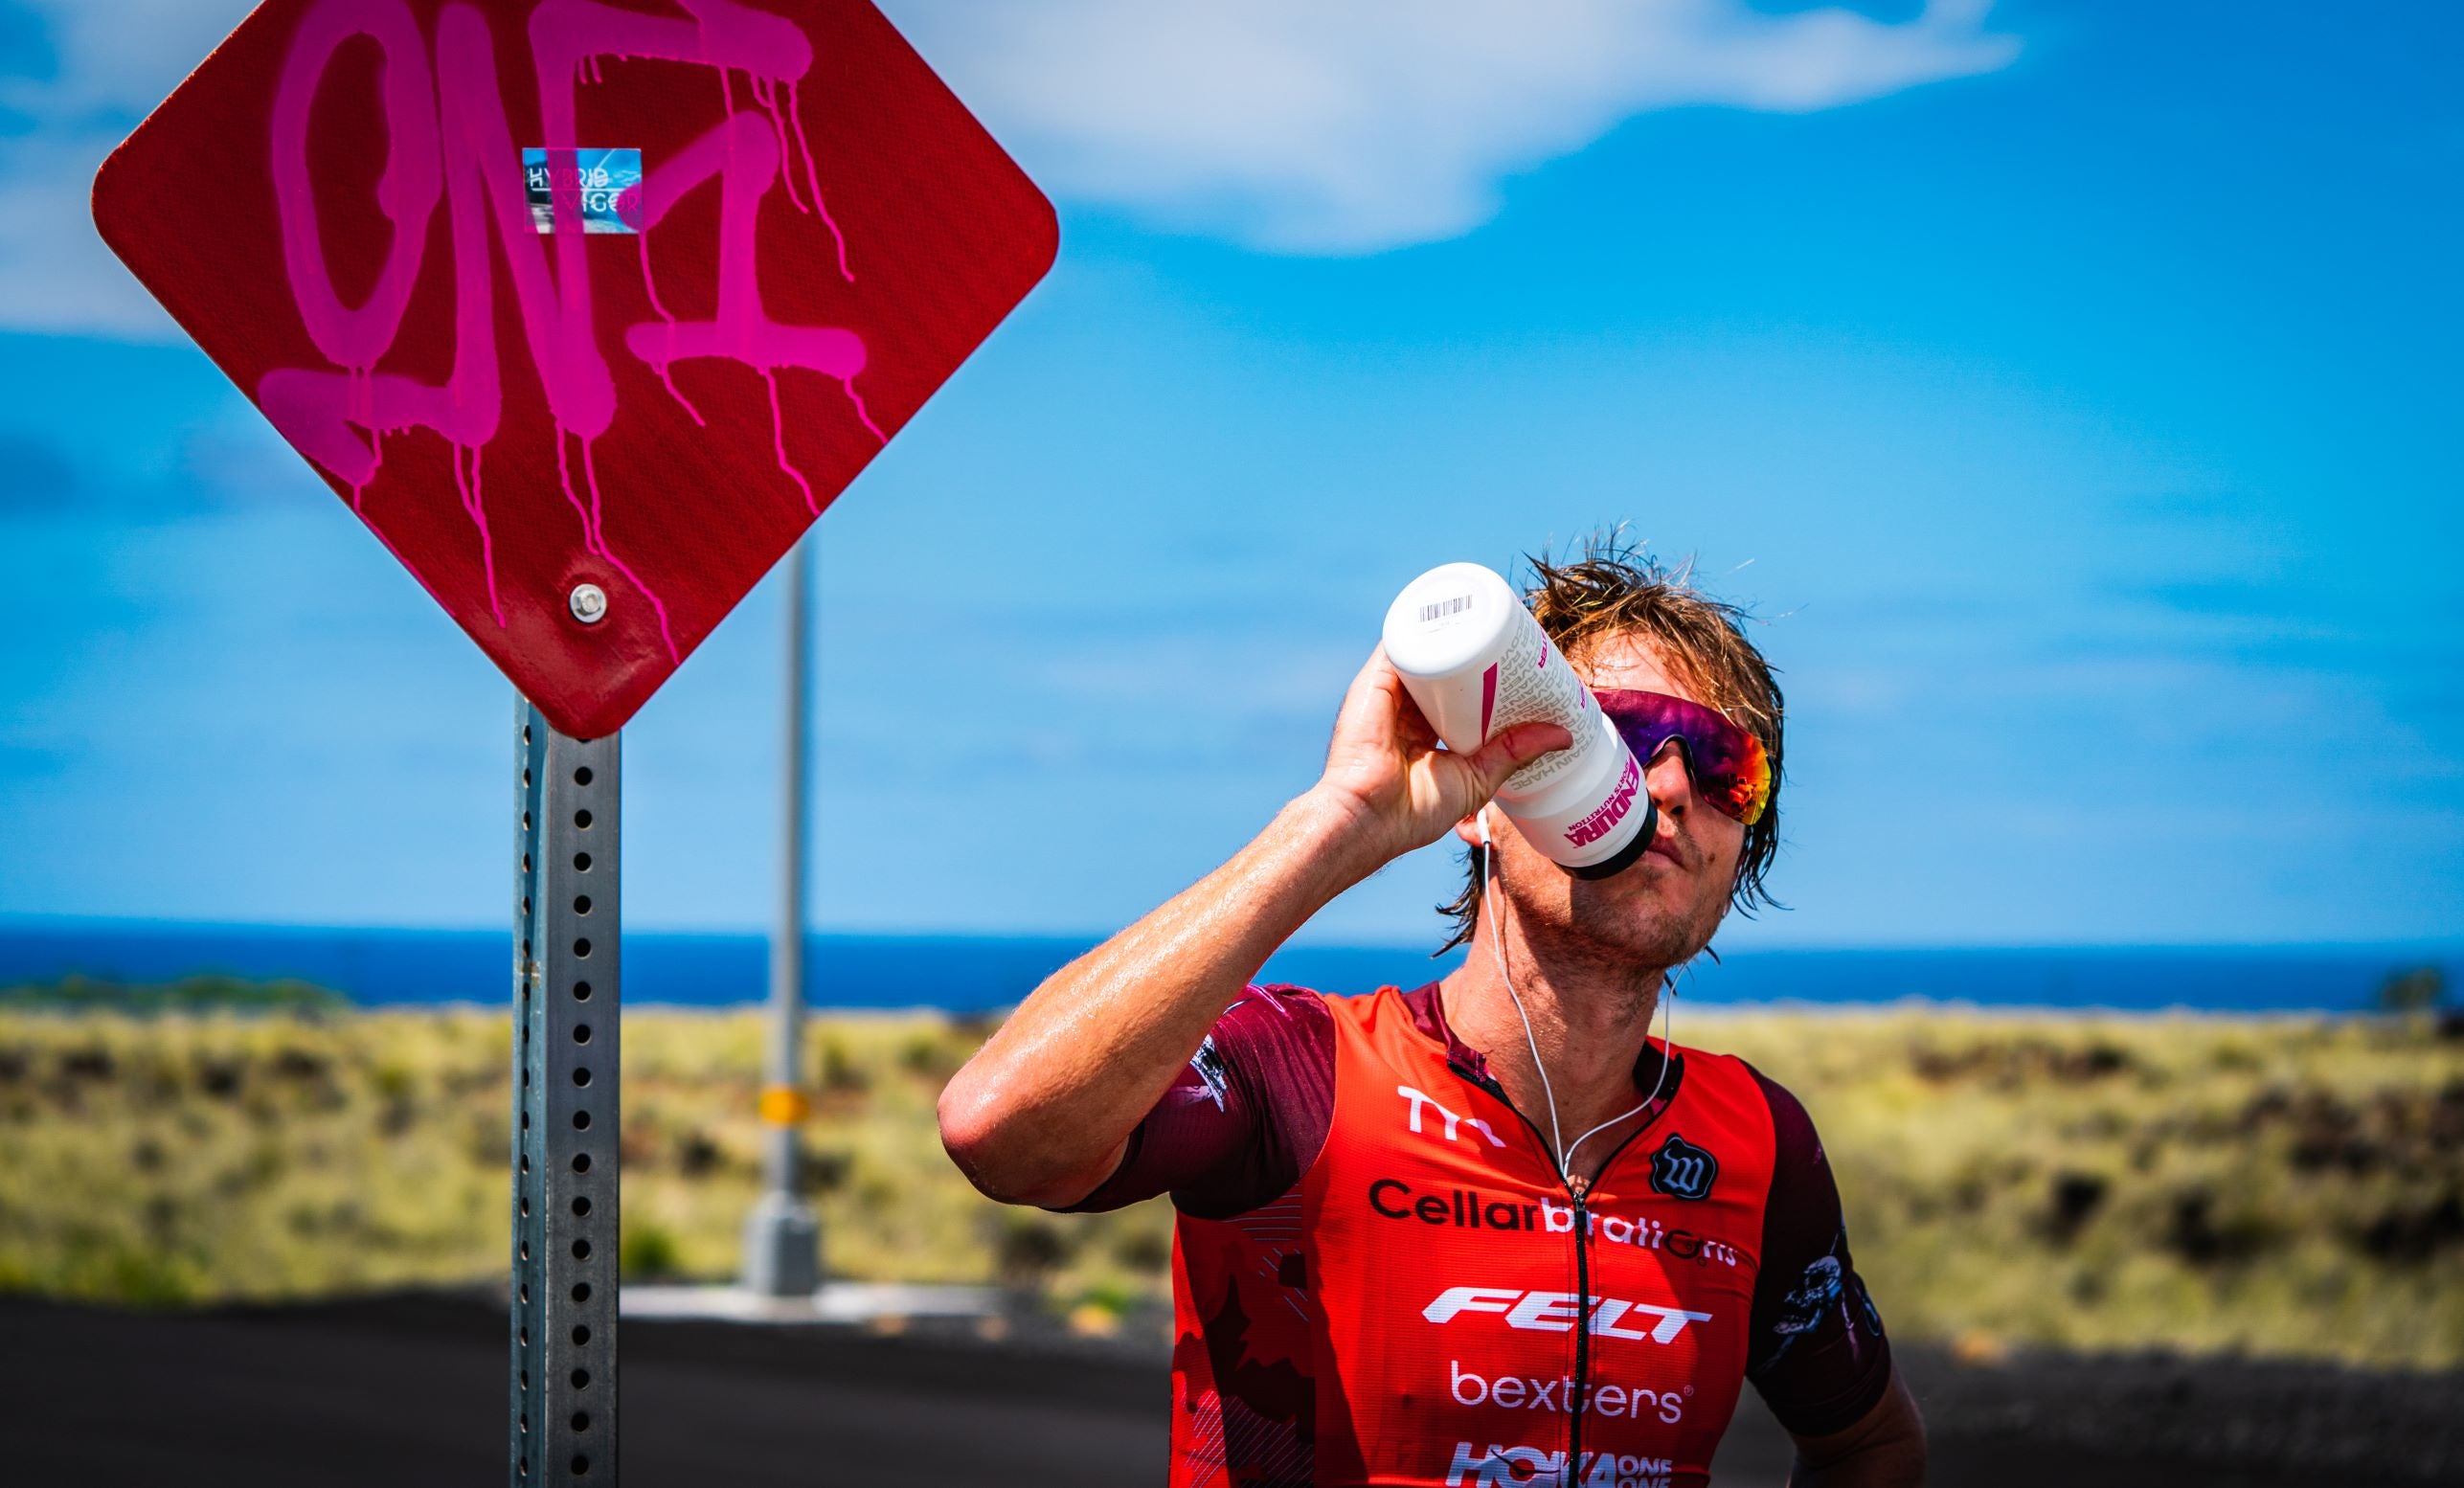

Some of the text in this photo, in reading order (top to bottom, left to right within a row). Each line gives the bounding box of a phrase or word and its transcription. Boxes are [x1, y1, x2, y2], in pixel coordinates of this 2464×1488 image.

[1564, 750, 1640, 847] ENDURA
[1568, 794, 1615, 831] NUTRITION
[1421, 1286, 1714, 1345] FELT
[1451, 1360, 1684, 1425] bexters
[1445, 1441, 1674, 1488] HOKA ONE
